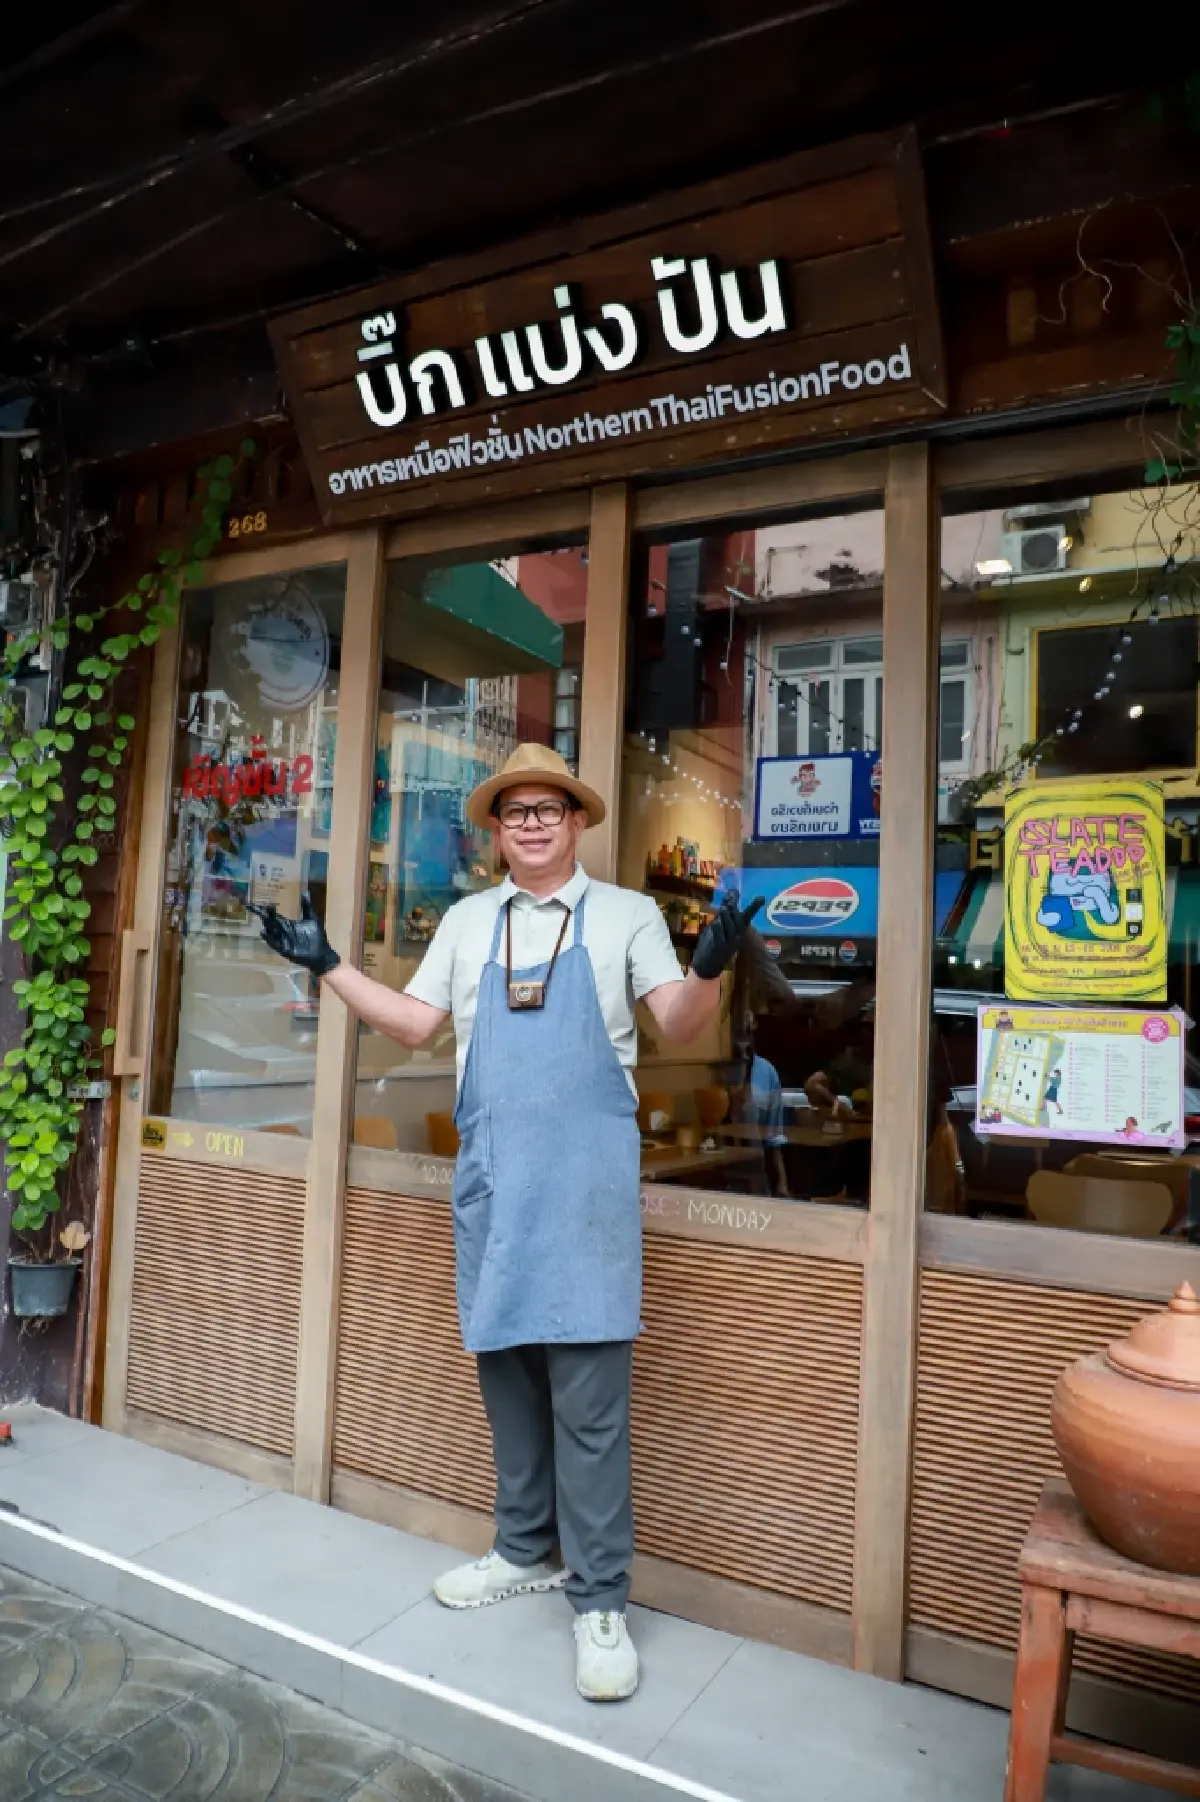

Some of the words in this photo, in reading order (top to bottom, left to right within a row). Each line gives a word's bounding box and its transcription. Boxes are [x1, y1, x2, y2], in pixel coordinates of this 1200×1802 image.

[355, 310, 466, 427] บิ๊ก
[474, 284, 638, 398] แบ่ง
[652, 256, 789, 354] ปัน
[229, 511, 267, 538] 268
[1019, 813, 1147, 846] SLATE
[205, 1131, 244, 1157] OPEN
[687, 1198, 773, 1232] MONDAY
